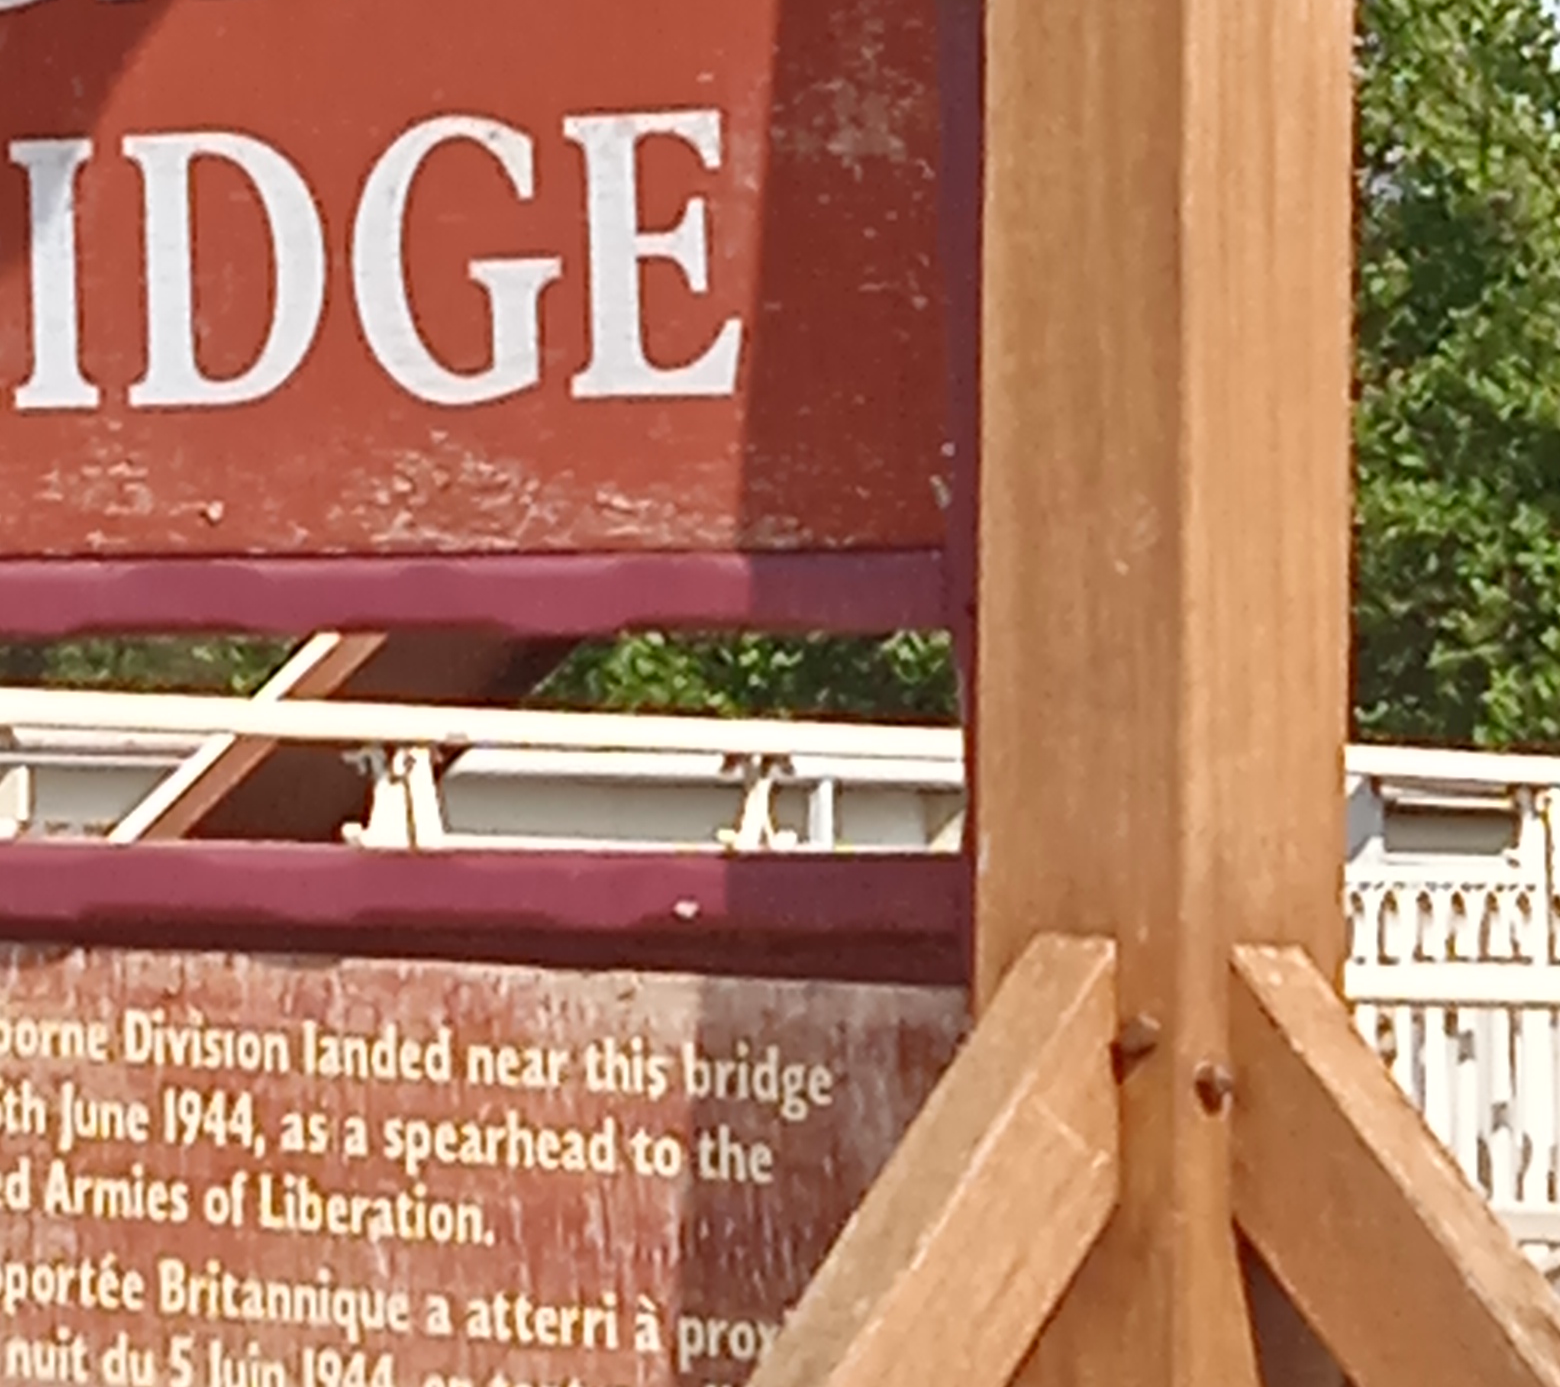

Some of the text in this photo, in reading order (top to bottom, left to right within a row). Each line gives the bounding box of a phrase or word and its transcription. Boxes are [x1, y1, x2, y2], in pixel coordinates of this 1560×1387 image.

[123, 1007, 290, 1075] Division
[302, 1020, 452, 1083] landed
[466, 1042, 570, 1089] near
[584, 1036, 670, 1101] this
[682, 1041, 835, 1121] bridge
[59, 1080, 151, 1153] June
[163, 1087, 268, 1159] 1944,
[280, 1111, 330, 1153] as
[344, 1117, 368, 1157] a
[382, 1109, 618, 1177] spearhead
[628, 1125, 683, 1179] to
[696, 1125, 776, 1185] the
[44, 1157, 190, 1223] Armies
[203, 1169, 247, 1229] of
[258, 1177, 496, 1247] Liberation.
[158, 1257, 412, 1343] Britannique
[425, 1293, 452, 1335] a
[466, 1291, 620, 1351] atterri
[634, 1295, 662, 1353] à
[6, 1325, 90, 1383] nuit
[102, 1331, 156, 1387] du
[170, 1331, 194, 1387] 5
